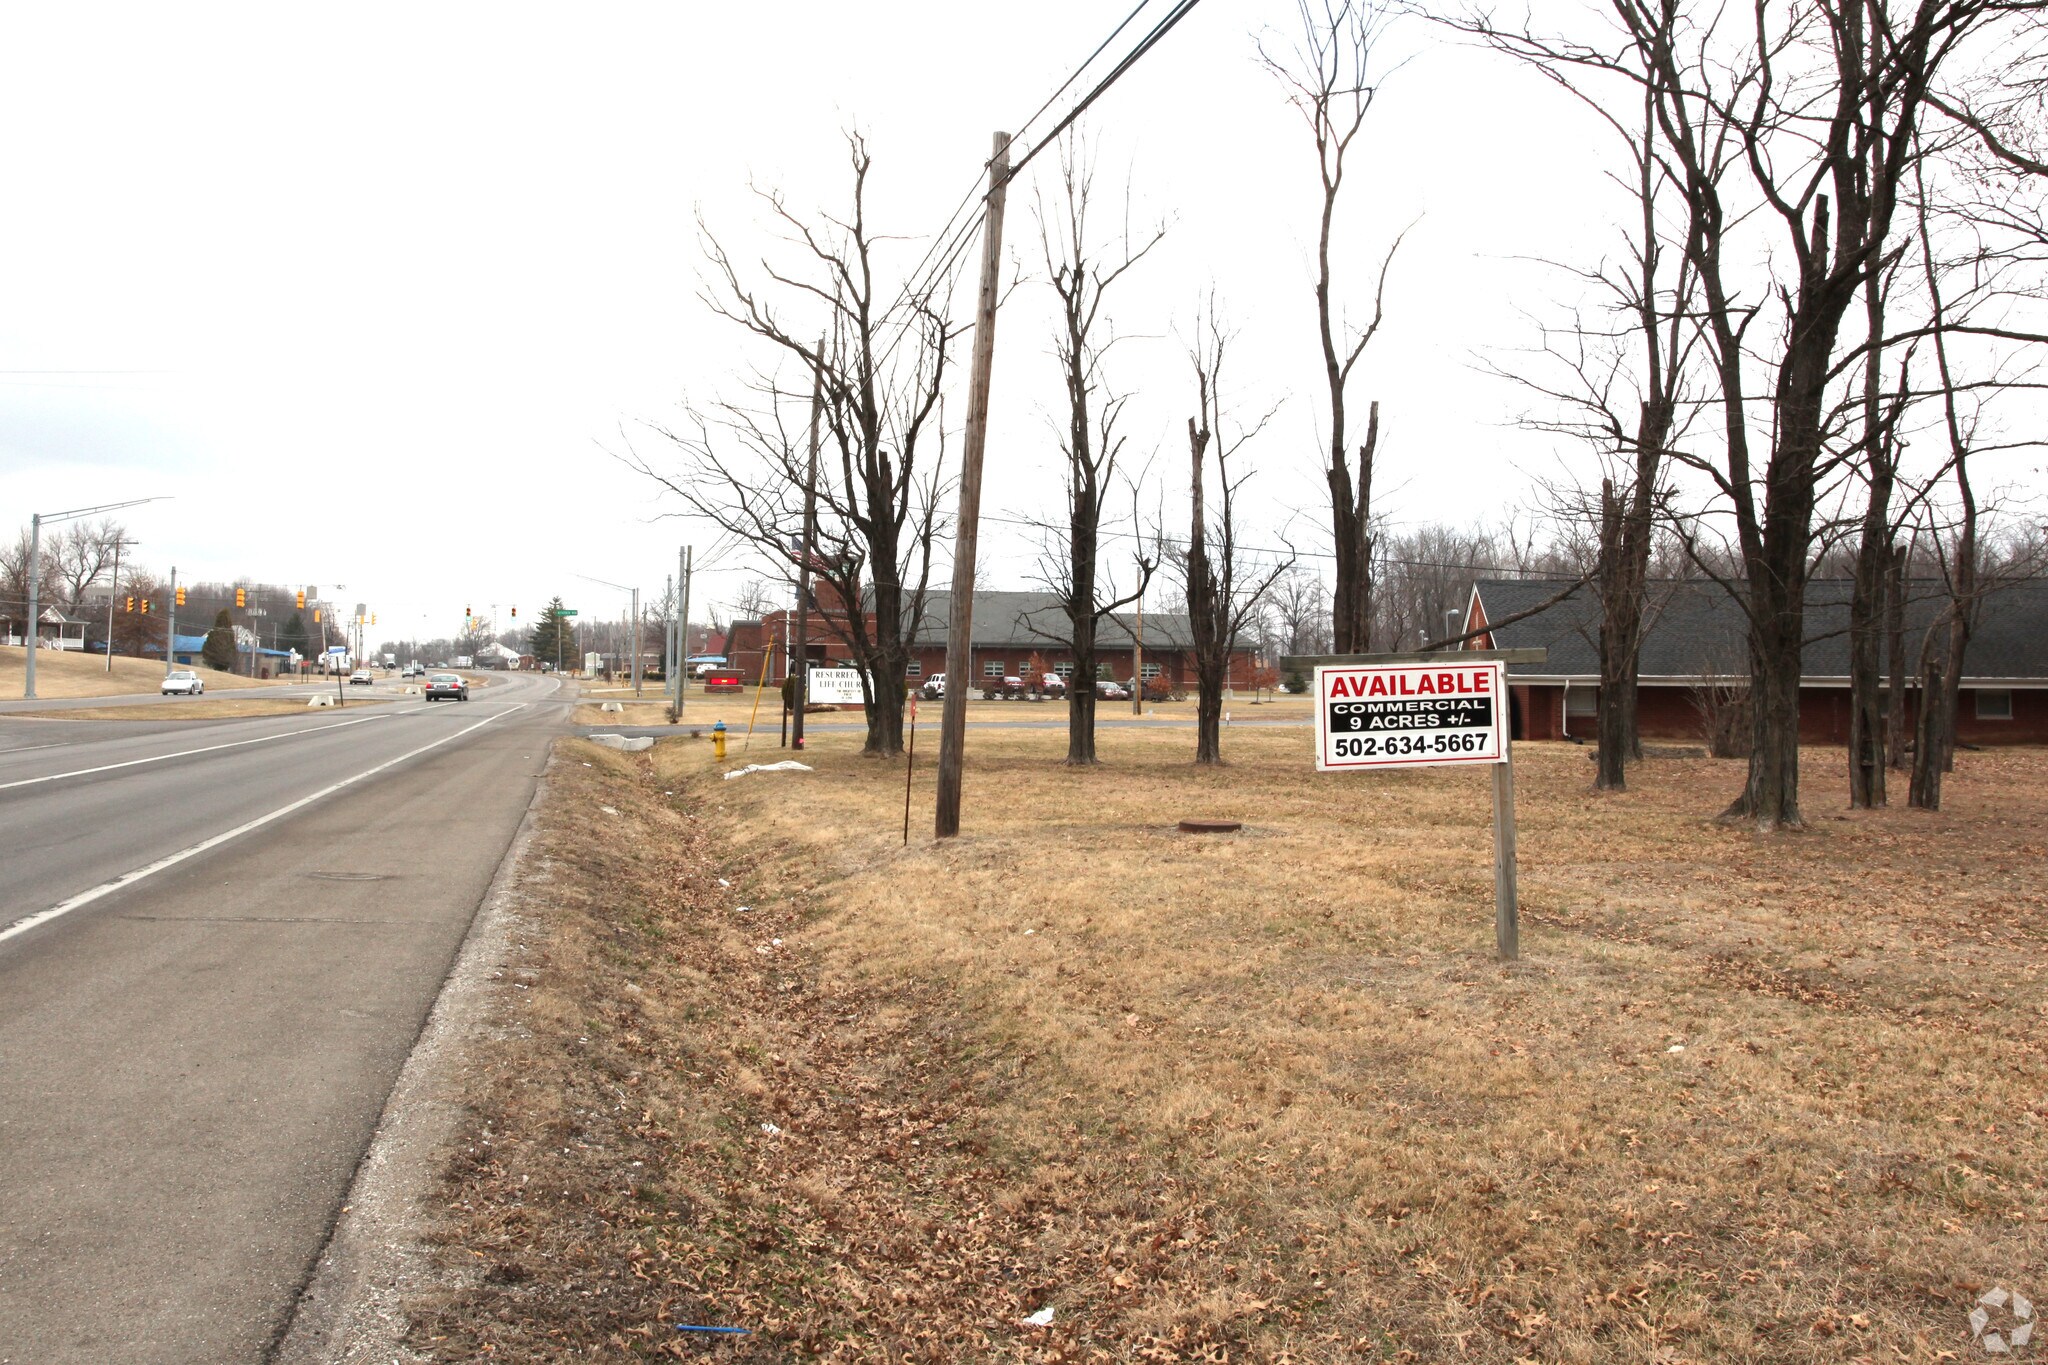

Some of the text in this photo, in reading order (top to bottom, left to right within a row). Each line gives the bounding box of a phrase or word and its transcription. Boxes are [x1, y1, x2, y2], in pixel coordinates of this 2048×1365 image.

[819, 680, 872, 688] LIFE CHUR
[1330, 672, 1490, 698] AVAILABLE
[1333, 699, 1485, 714] COMMERCIAL
[1350, 712, 1471, 730] 9 ACRES +/-
[1335, 733, 1488, 757] 502-634-5667
